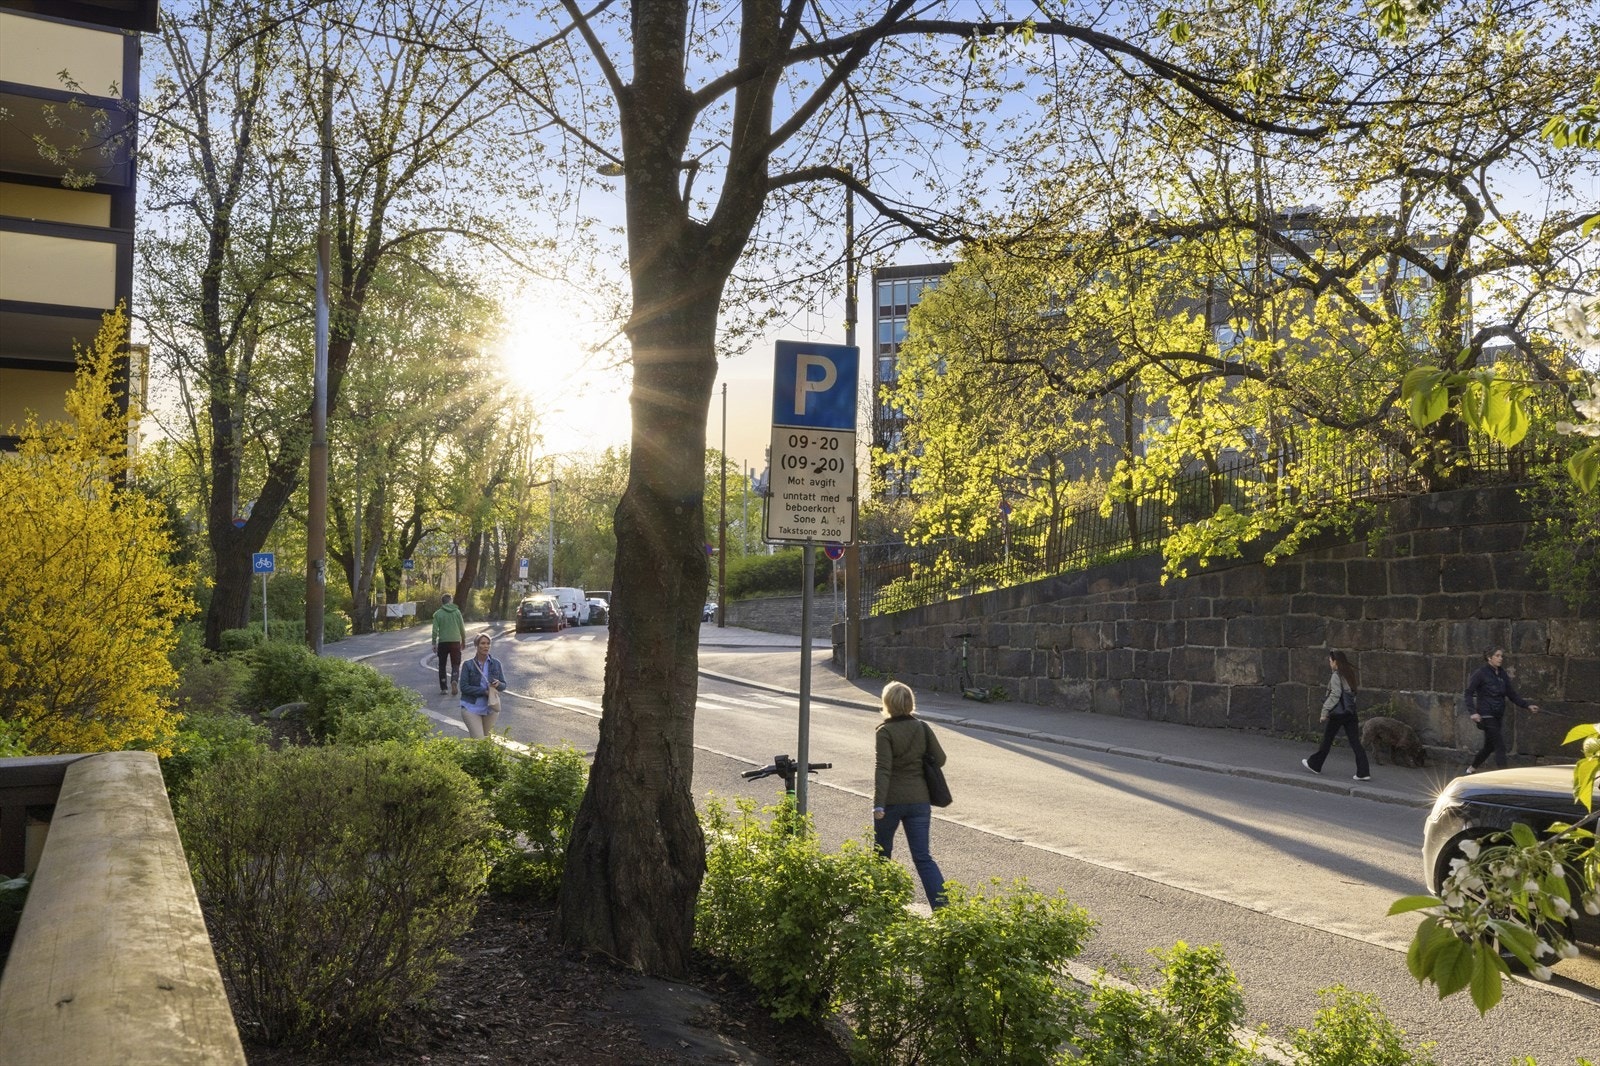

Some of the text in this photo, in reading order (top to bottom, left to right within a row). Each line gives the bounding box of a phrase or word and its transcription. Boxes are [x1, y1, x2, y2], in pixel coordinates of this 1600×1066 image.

[795, 354, 837, 415] P
[788, 476, 836, 488] Mot avgift
[783, 493, 840, 503] unntatt med
[785, 503, 836, 513] beboerkort
[793, 515, 816, 524] Sone
[779, 527, 841, 537] Takstsone 2300
